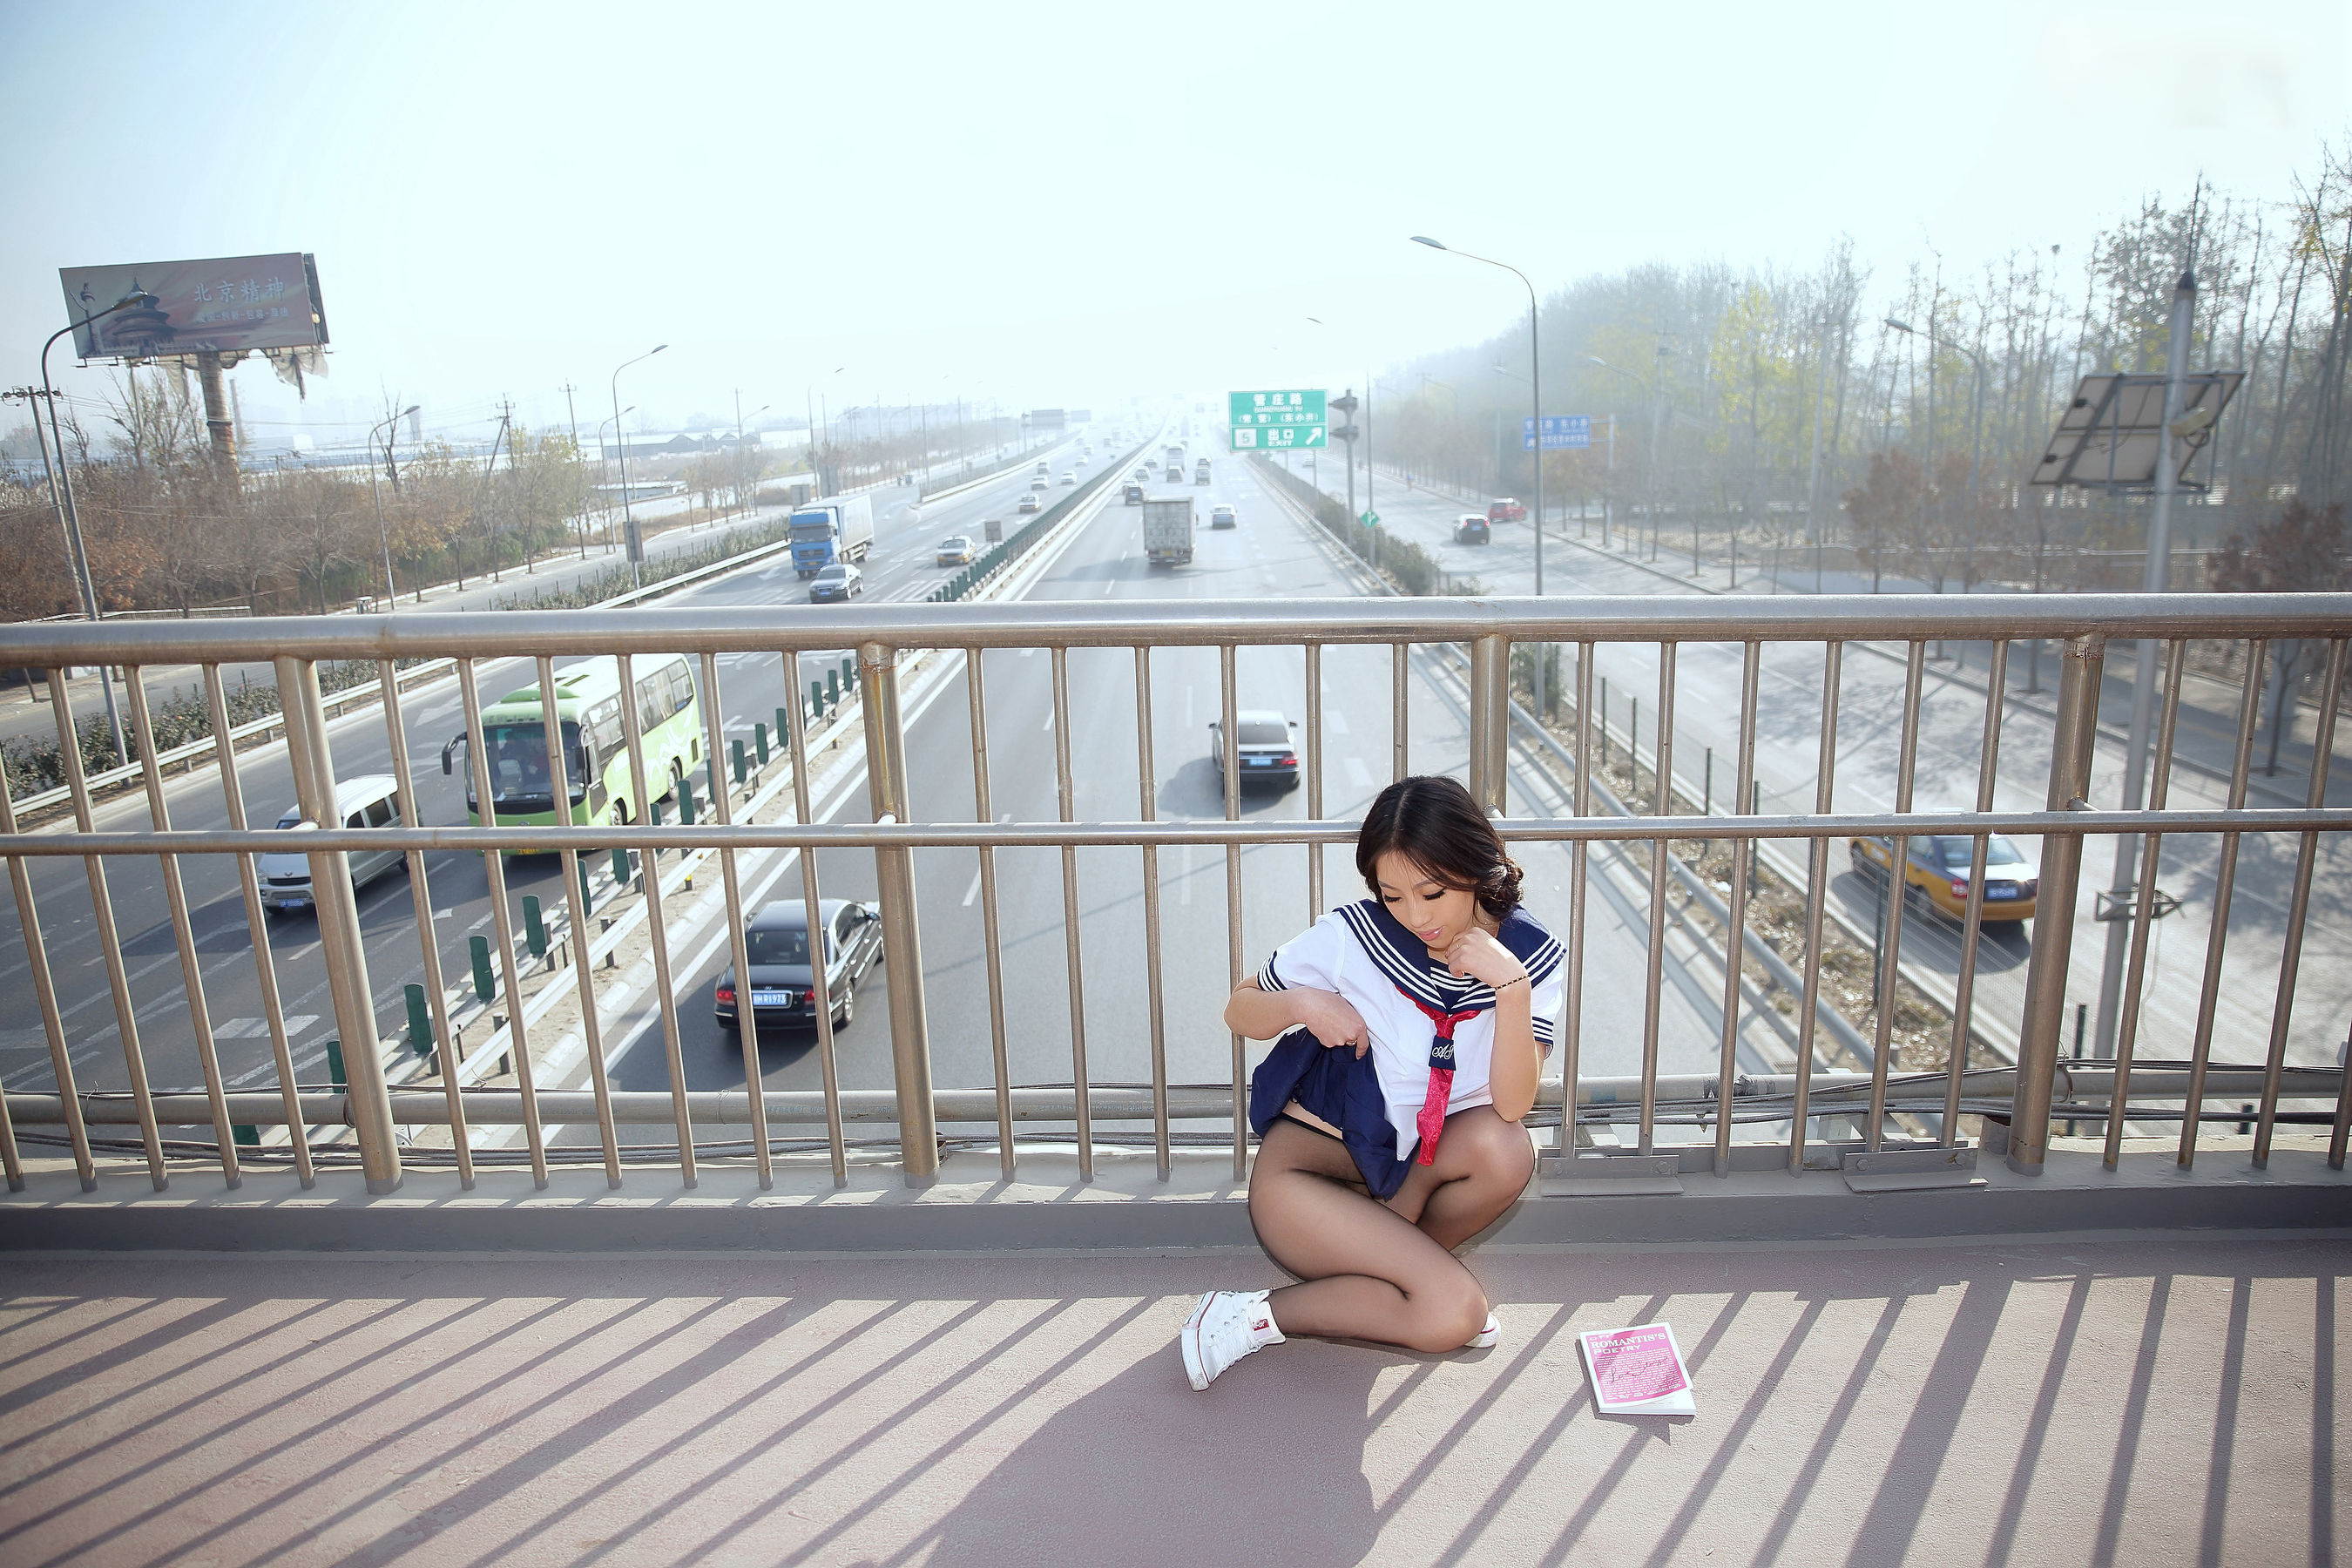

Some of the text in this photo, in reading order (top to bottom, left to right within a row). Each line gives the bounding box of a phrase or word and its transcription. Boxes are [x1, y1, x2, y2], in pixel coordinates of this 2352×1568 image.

[195, 276, 286, 302] 北京精神
[1267, 428, 1294, 440] 出口
[1593, 1344, 1641, 1355] POETRY
